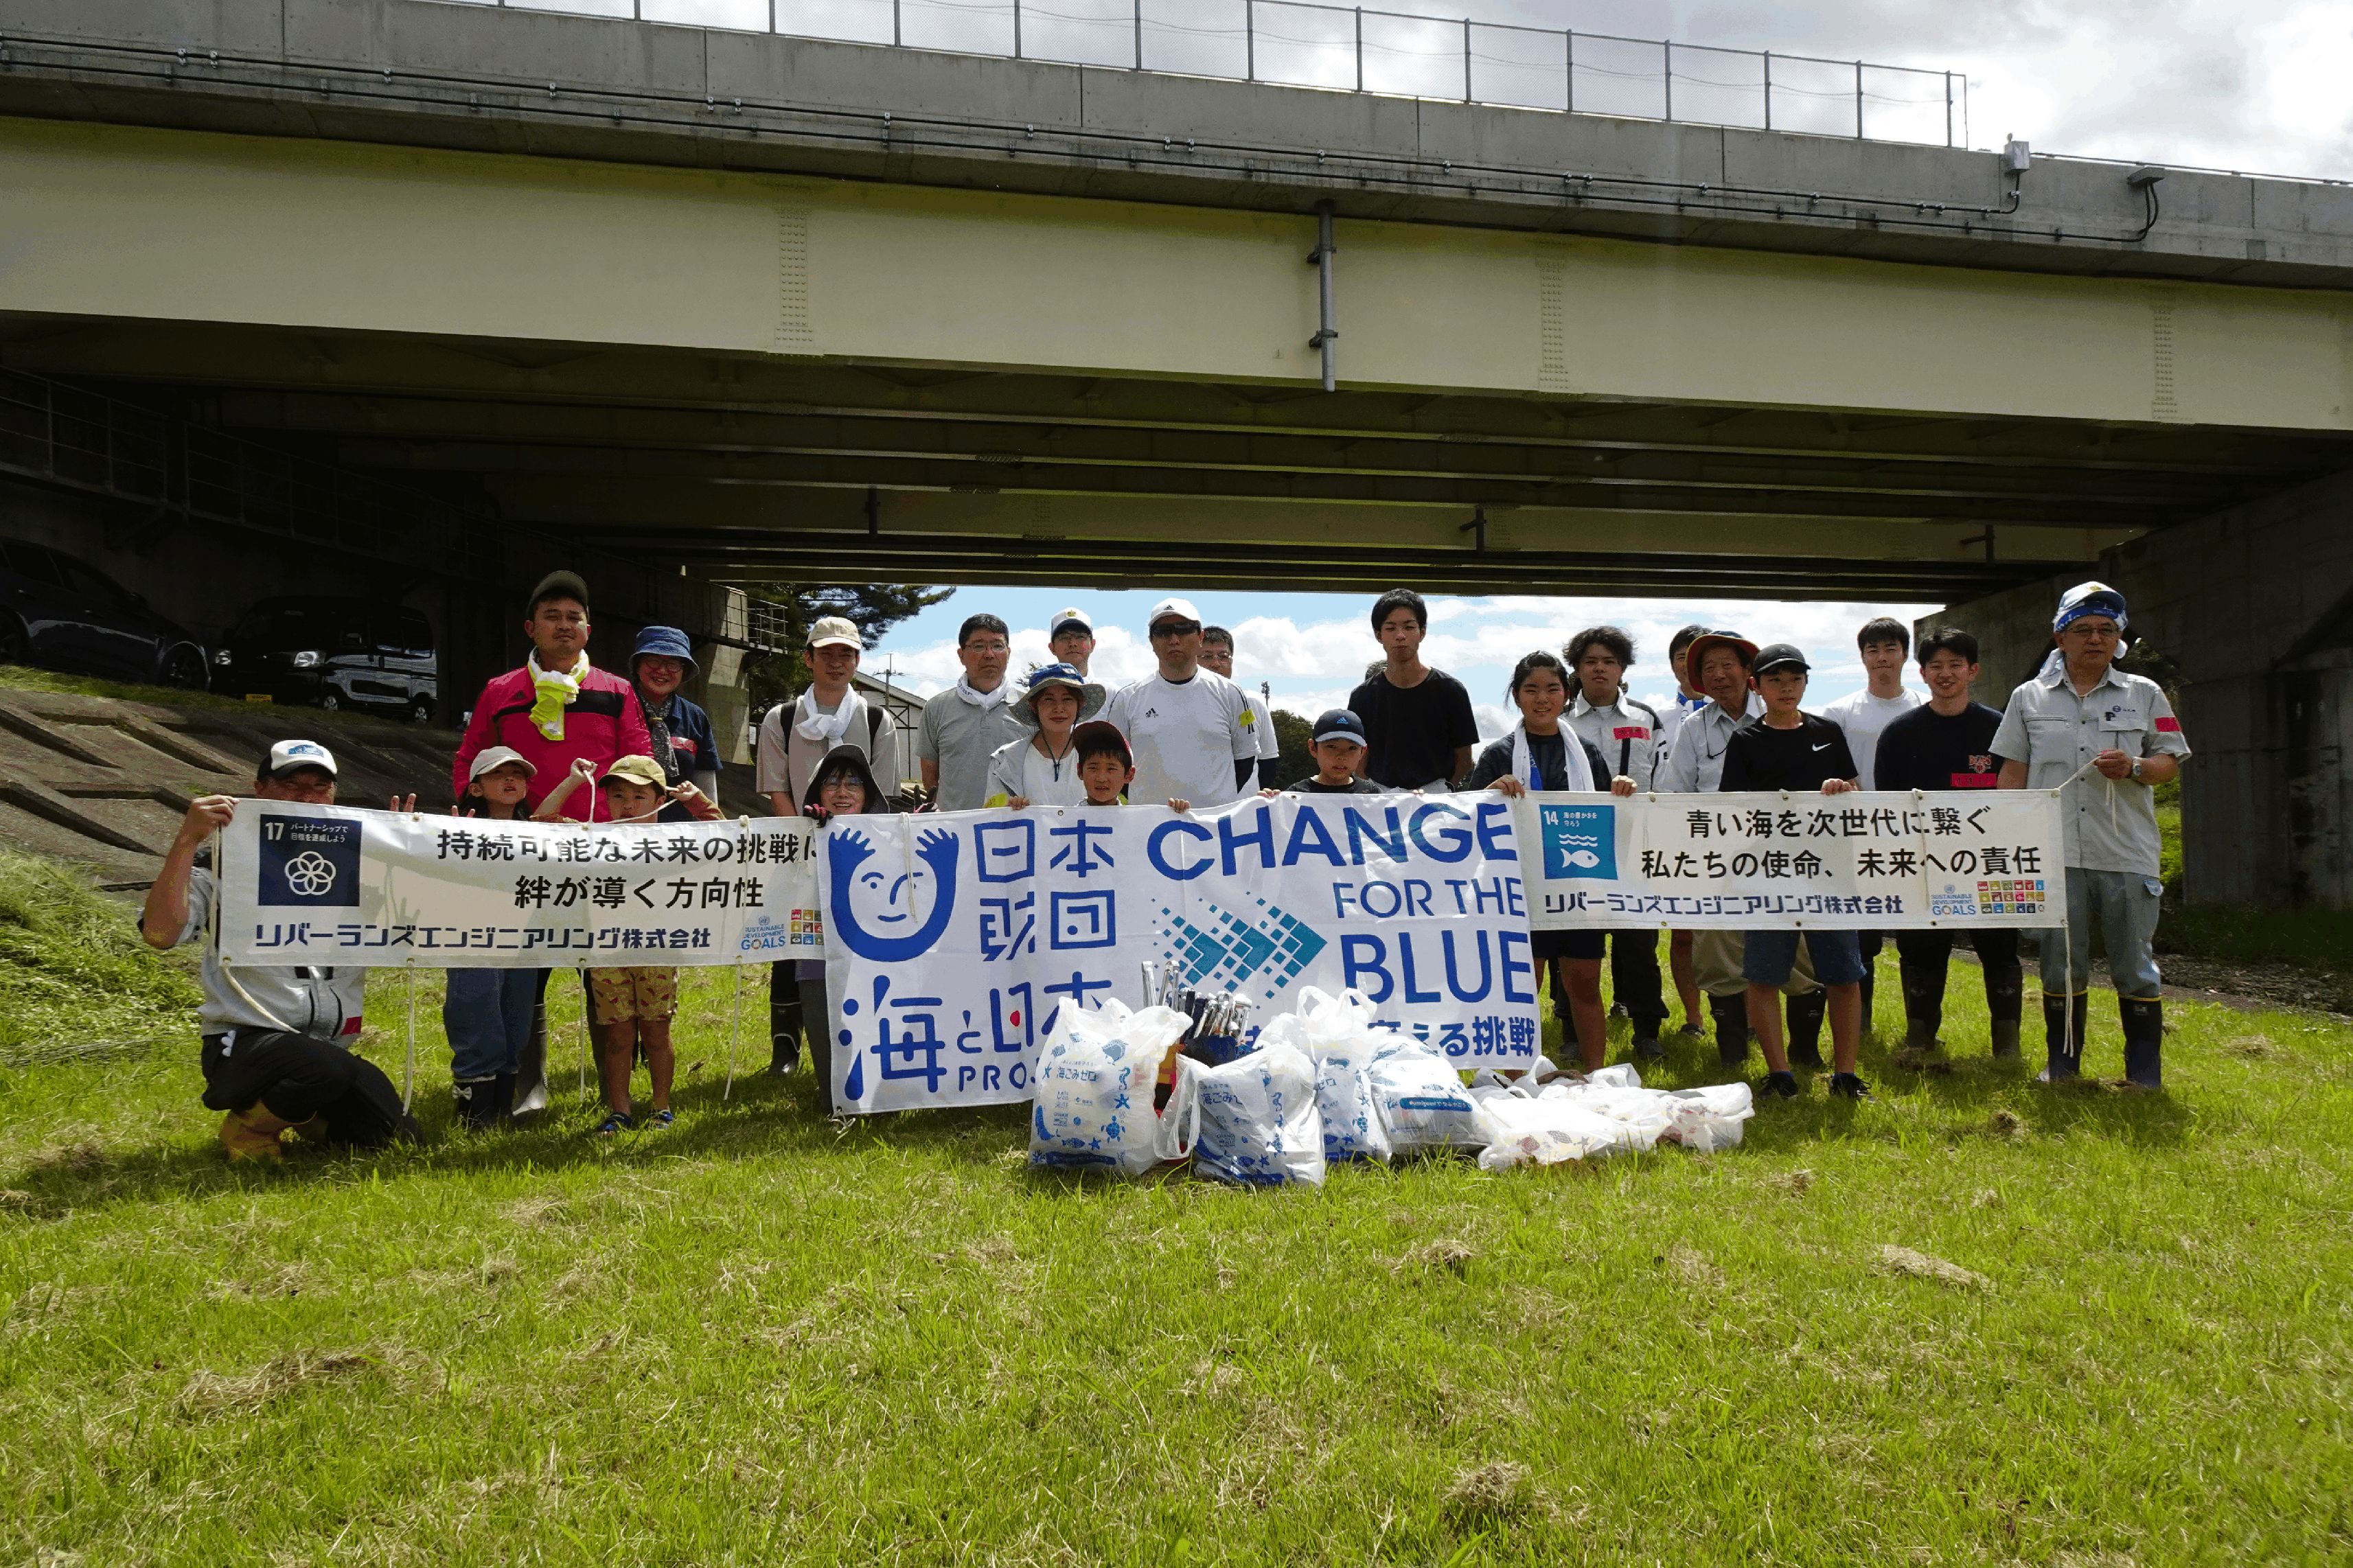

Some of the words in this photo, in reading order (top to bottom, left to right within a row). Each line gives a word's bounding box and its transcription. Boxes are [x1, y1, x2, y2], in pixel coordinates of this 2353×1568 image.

[265, 822, 284, 840] 17
[290, 824, 349, 833] パートナーシップで
[1543, 811, 1559, 825] 14
[1686, 806, 1990, 839] 青い海を次世代に繋ぐ
[974, 818, 1114, 883] 日本
[1147, 803, 1517, 881] CHANGE
[1642, 846, 2041, 879] 私たちの使命、未来への責任
[515, 875, 764, 910] 絆が導く方向性
[1333, 879, 1434, 919] FOR
[1445, 877, 1526, 918] THE
[1546, 891, 1904, 915] リバーランズエンジニアリング株式会社
[1932, 905, 1976, 915] GOALS
[255, 922, 711, 950] リバーランズエンジニアリング株式会社
[741, 936, 785, 950] GOALS
[1340, 930, 1535, 1006] BLUE
[959, 1063, 1037, 1092] PRO
